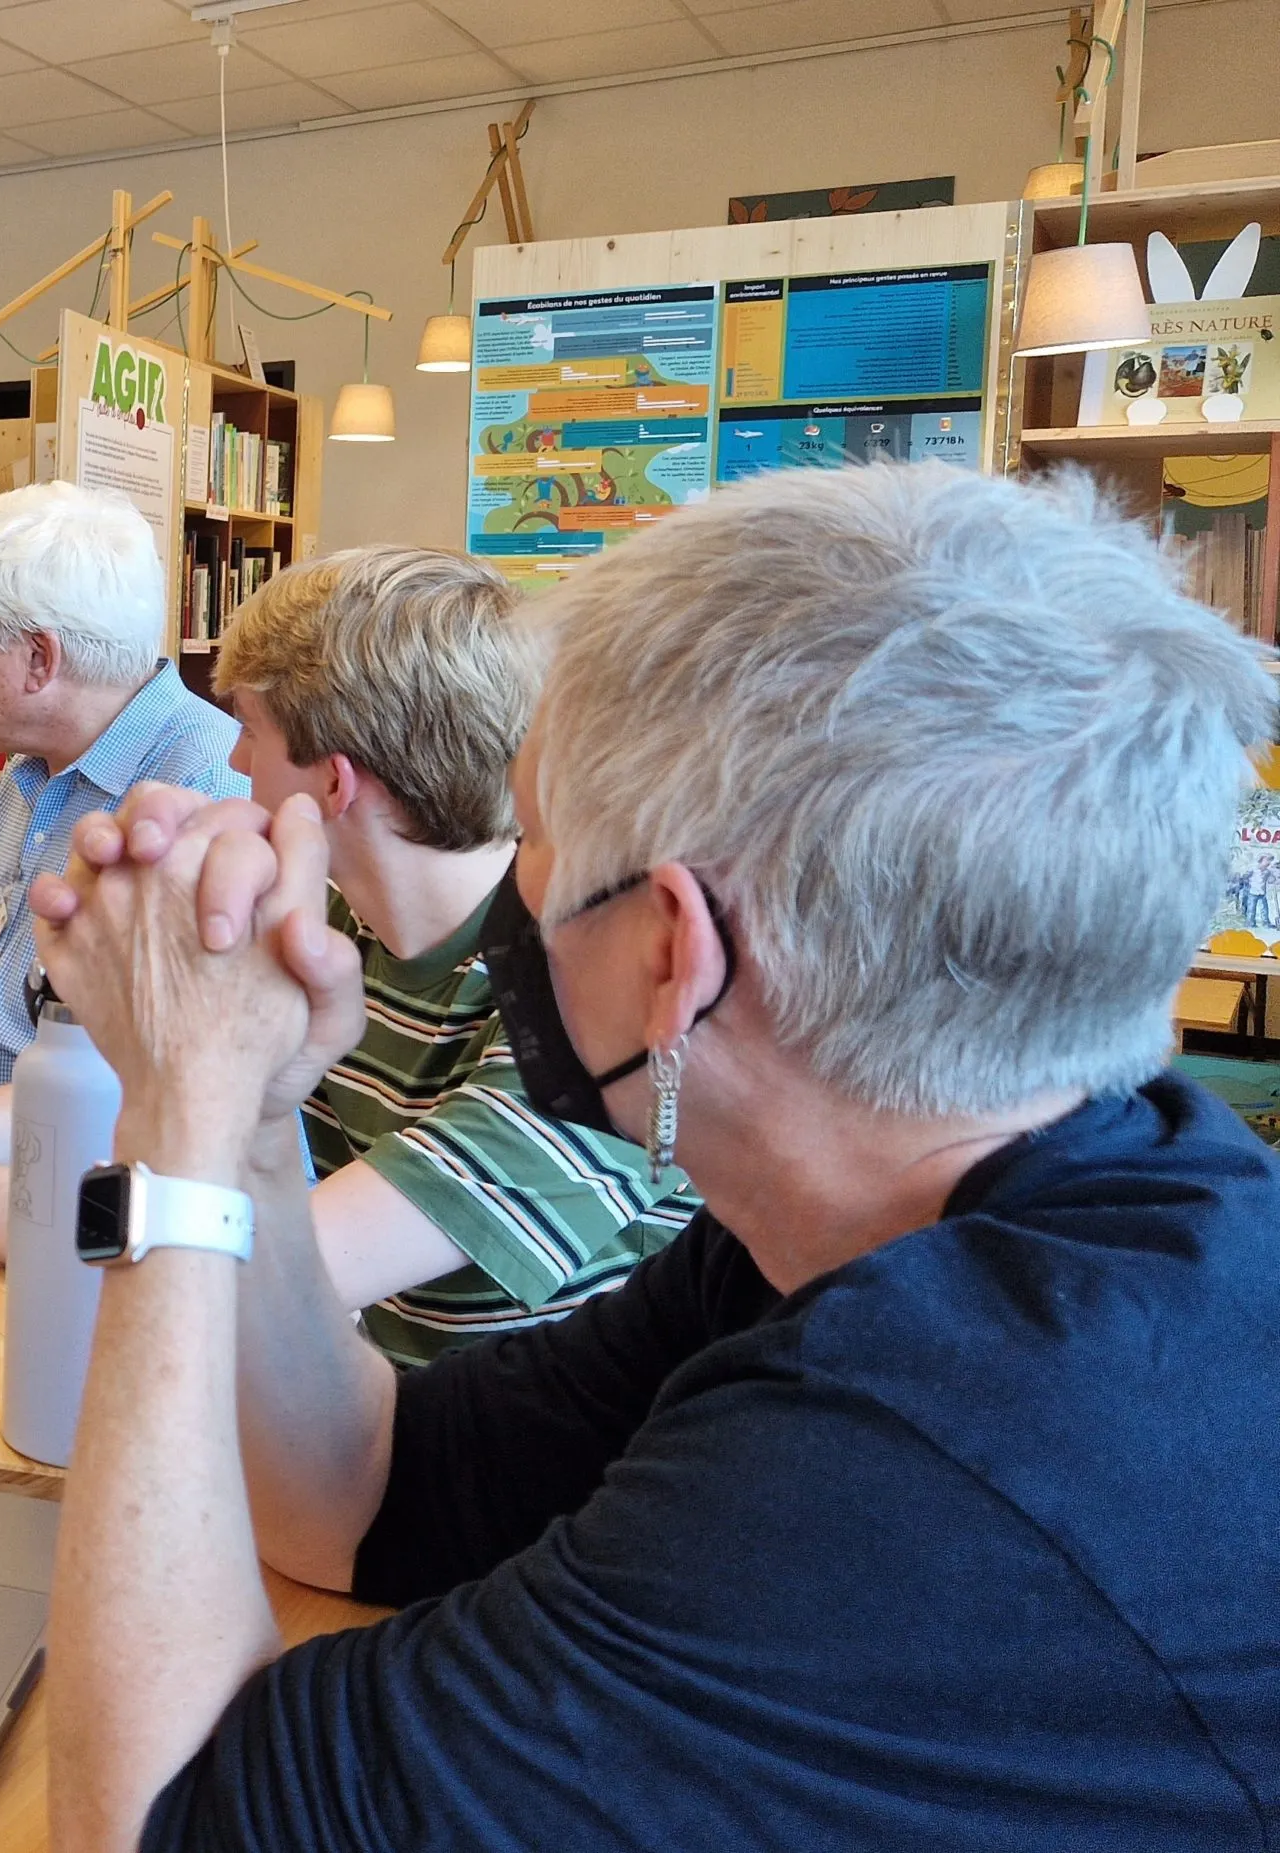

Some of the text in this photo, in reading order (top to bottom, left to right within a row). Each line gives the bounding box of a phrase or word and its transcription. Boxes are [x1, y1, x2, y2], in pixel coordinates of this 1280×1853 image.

[842, 275, 875, 285] principaux
[875, 273, 897, 283] gestes
[744, 283, 766, 291] Impact
[729, 289, 780, 299] environnemental
[527, 300, 563, 310] Écobilans
[563, 299, 573, 307] de
[588, 297, 613, 307] gestes
[613, 294, 624, 303] du
[624, 293, 662, 303] quotidien
[1190, 315, 1273, 333] NATURE
[91, 342, 166, 431] AGIR
[813, 405, 883, 414] Quelques équivalences
